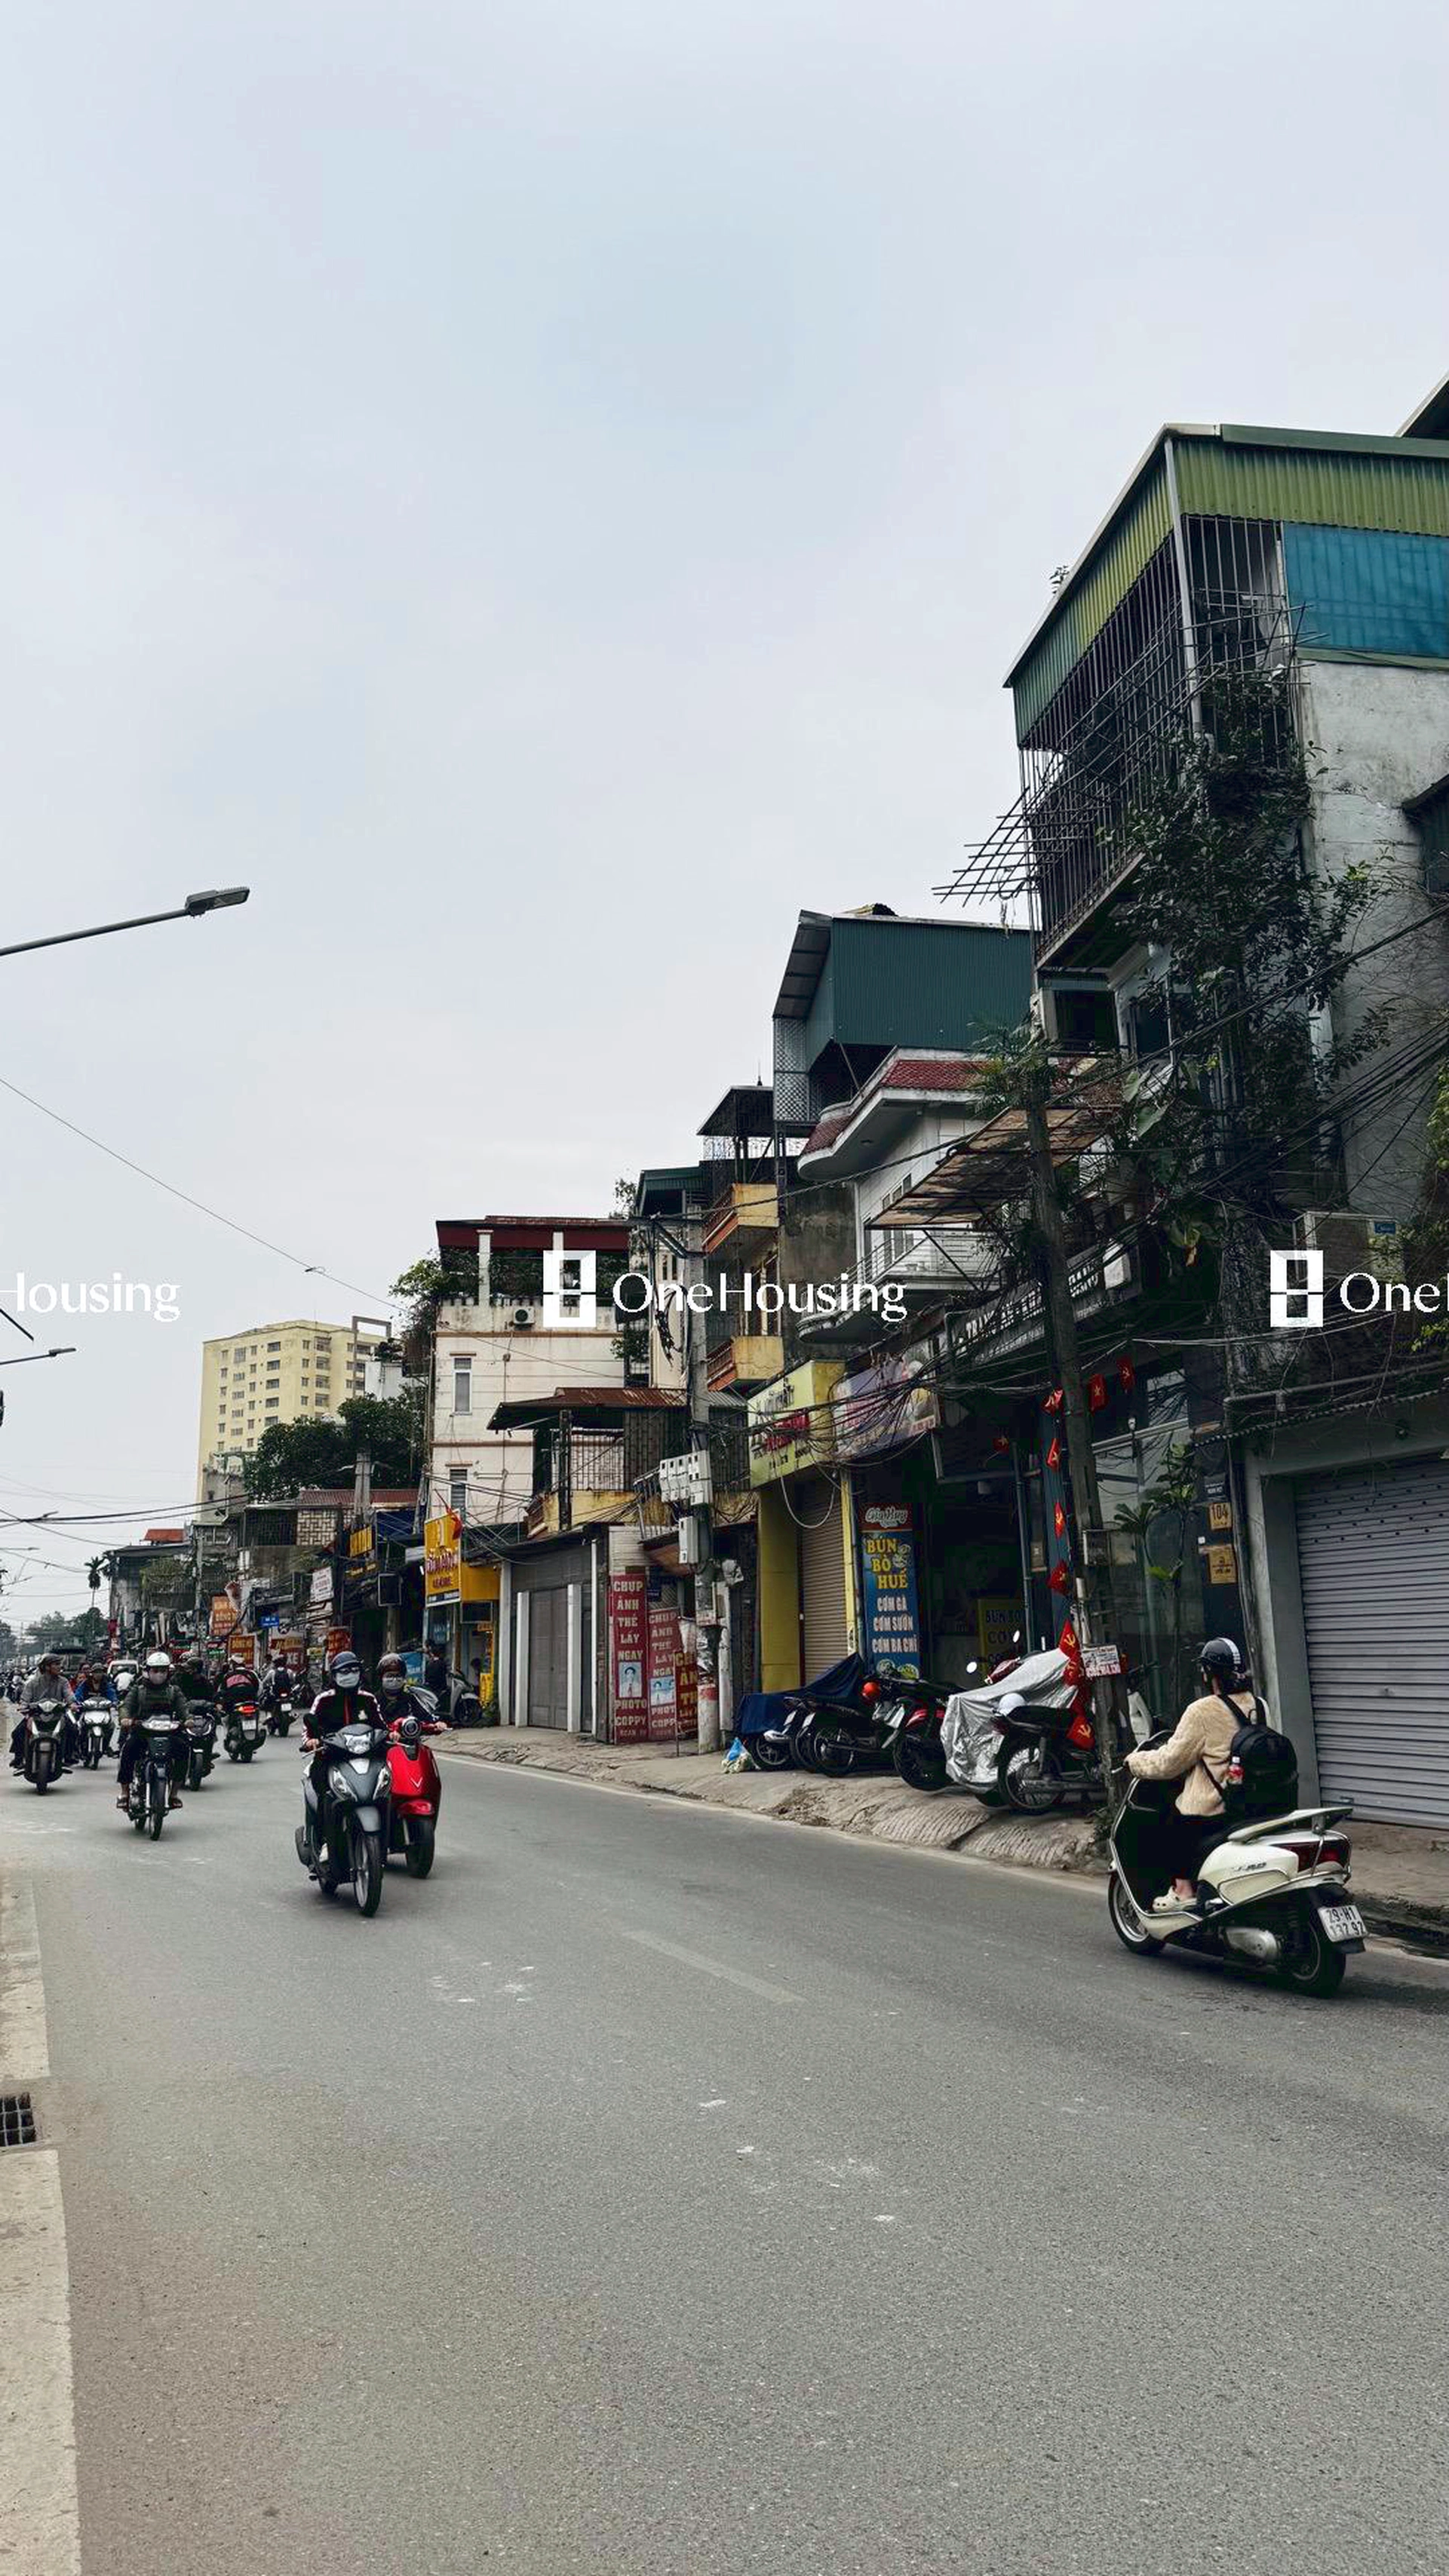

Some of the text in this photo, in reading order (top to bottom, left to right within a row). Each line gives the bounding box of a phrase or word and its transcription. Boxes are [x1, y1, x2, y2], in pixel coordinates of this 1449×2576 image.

[1212, 1505, 1228, 1520] 104
[867, 1535, 898, 1554] BÚN
[872, 1554, 892, 1572] BÒ
[877, 1567, 908, 1589] HUẾ
[873, 1616, 891, 1632] CƠM
[872, 1637, 890, 1653] CƠM
[891, 1638, 902, 1652] BA
[617, 1650, 643, 1661] NGAY
[614, 1699, 647, 1709] PHOTO
[615, 1715, 646, 1726] COPPY
[1326, 1907, 1355, 1922] 29-H1
